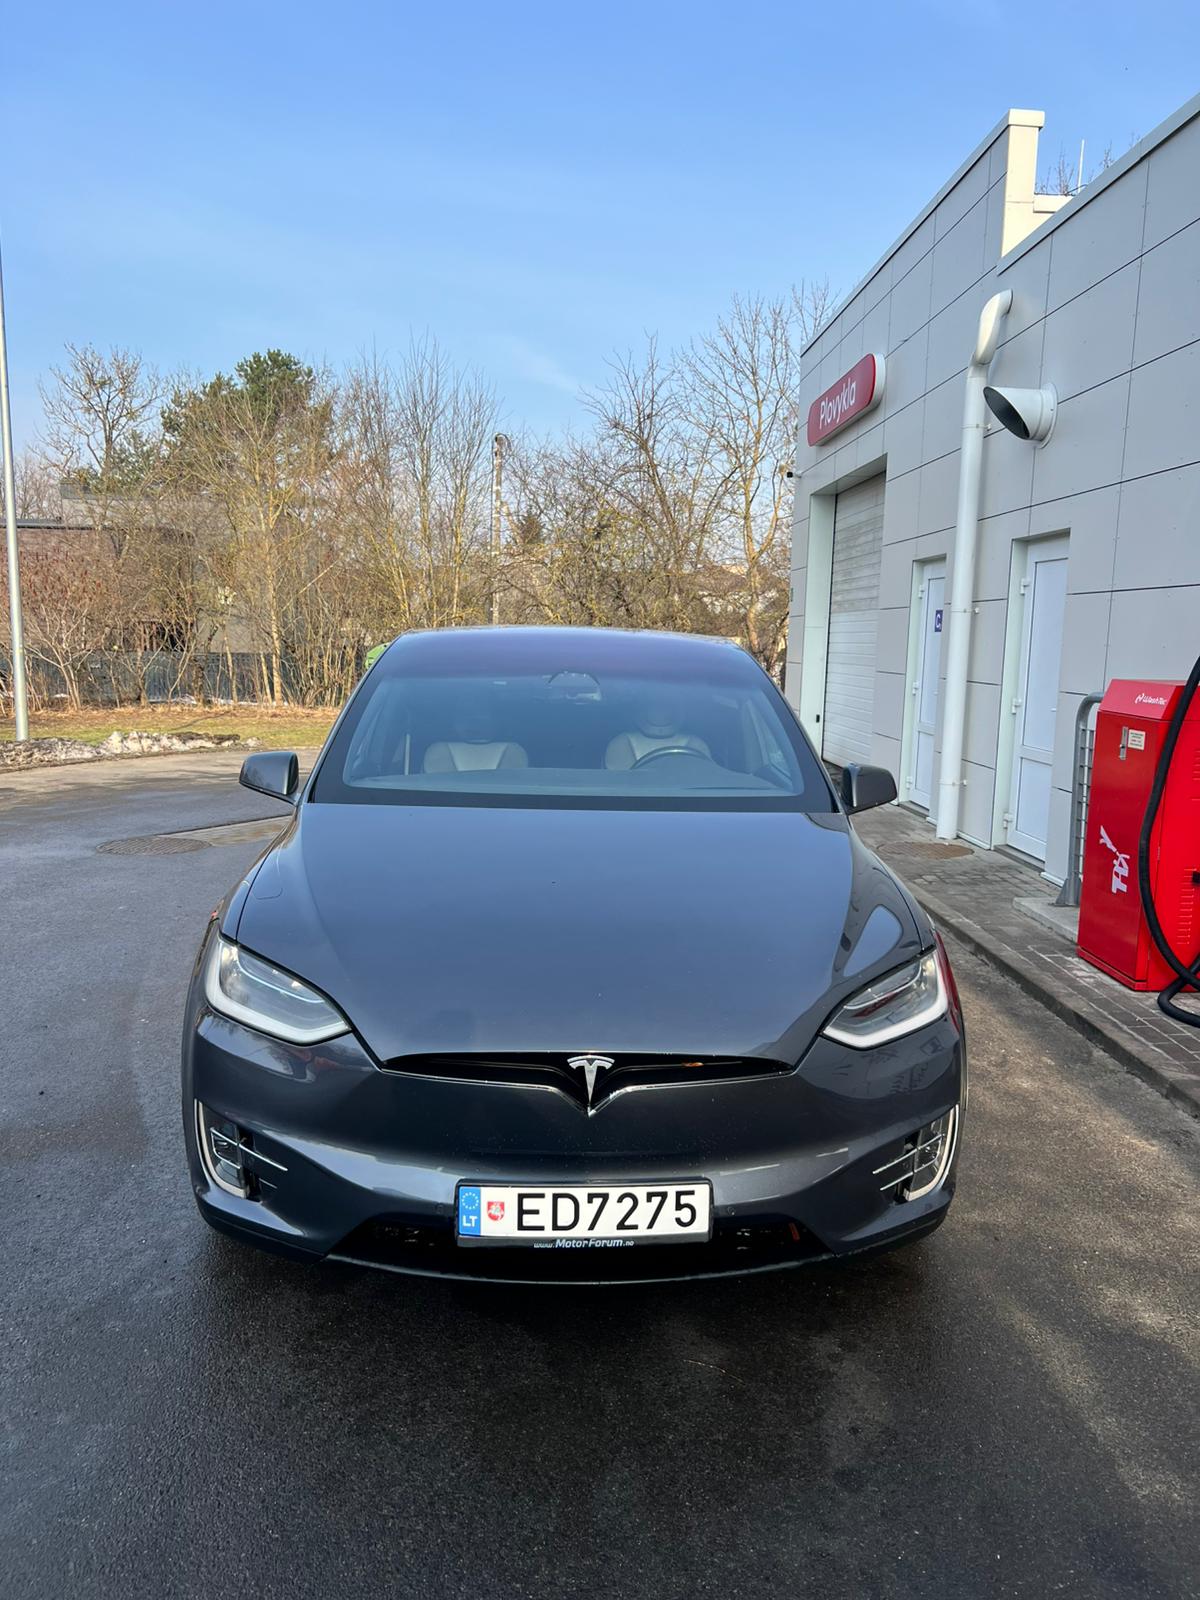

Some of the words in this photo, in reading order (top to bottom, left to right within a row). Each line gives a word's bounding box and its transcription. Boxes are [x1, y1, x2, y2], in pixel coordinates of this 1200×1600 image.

[819, 378, 856, 429] Plovykla
[462, 1215, 477, 1227] LT
[517, 1190, 697, 1231] ED7275
